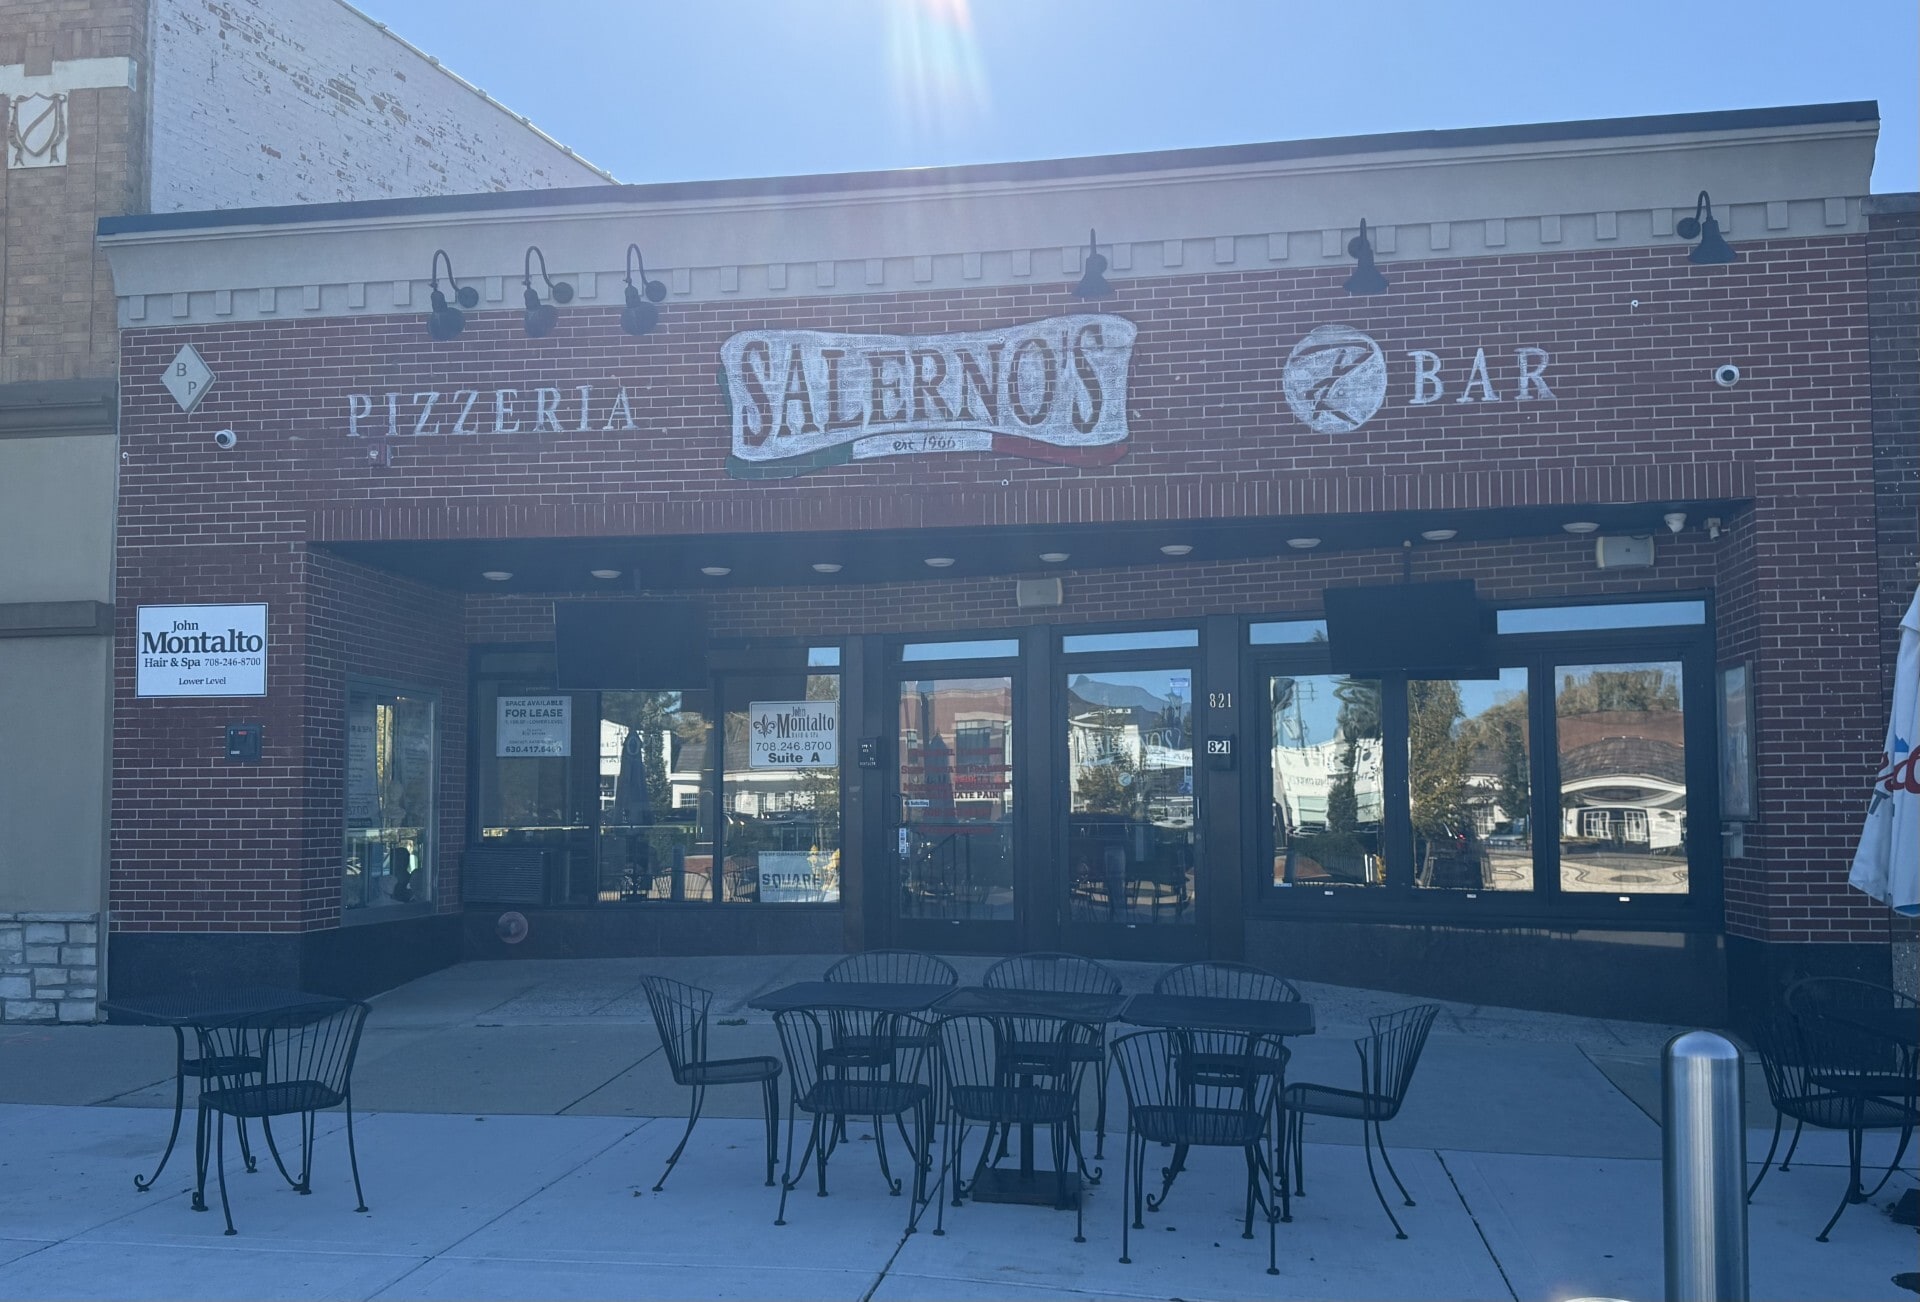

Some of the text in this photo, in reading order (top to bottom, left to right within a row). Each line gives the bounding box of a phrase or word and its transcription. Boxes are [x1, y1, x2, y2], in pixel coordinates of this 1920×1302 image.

[176, 362, 187, 377] B
[1407, 347, 1557, 404] BAR
[188, 381, 197, 395] P
[740, 323, 1106, 447] SALERNO'S
[346, 385, 640, 437] PIZZERIA
[171, 620, 199, 633] John
[141, 629, 263, 654] Montalto
[144, 657, 261, 669] Hair & Spa 708-246-8700
[205, 677, 227, 685] Level
[1209, 692, 1232, 708] 821
[505, 709, 563, 717] FOR LEASE
[776, 713, 835, 738] Montalto
[756, 741, 832, 752] 708.246.8700
[1209, 742, 1229, 753] 821
[768, 752, 820, 763] Suite A
